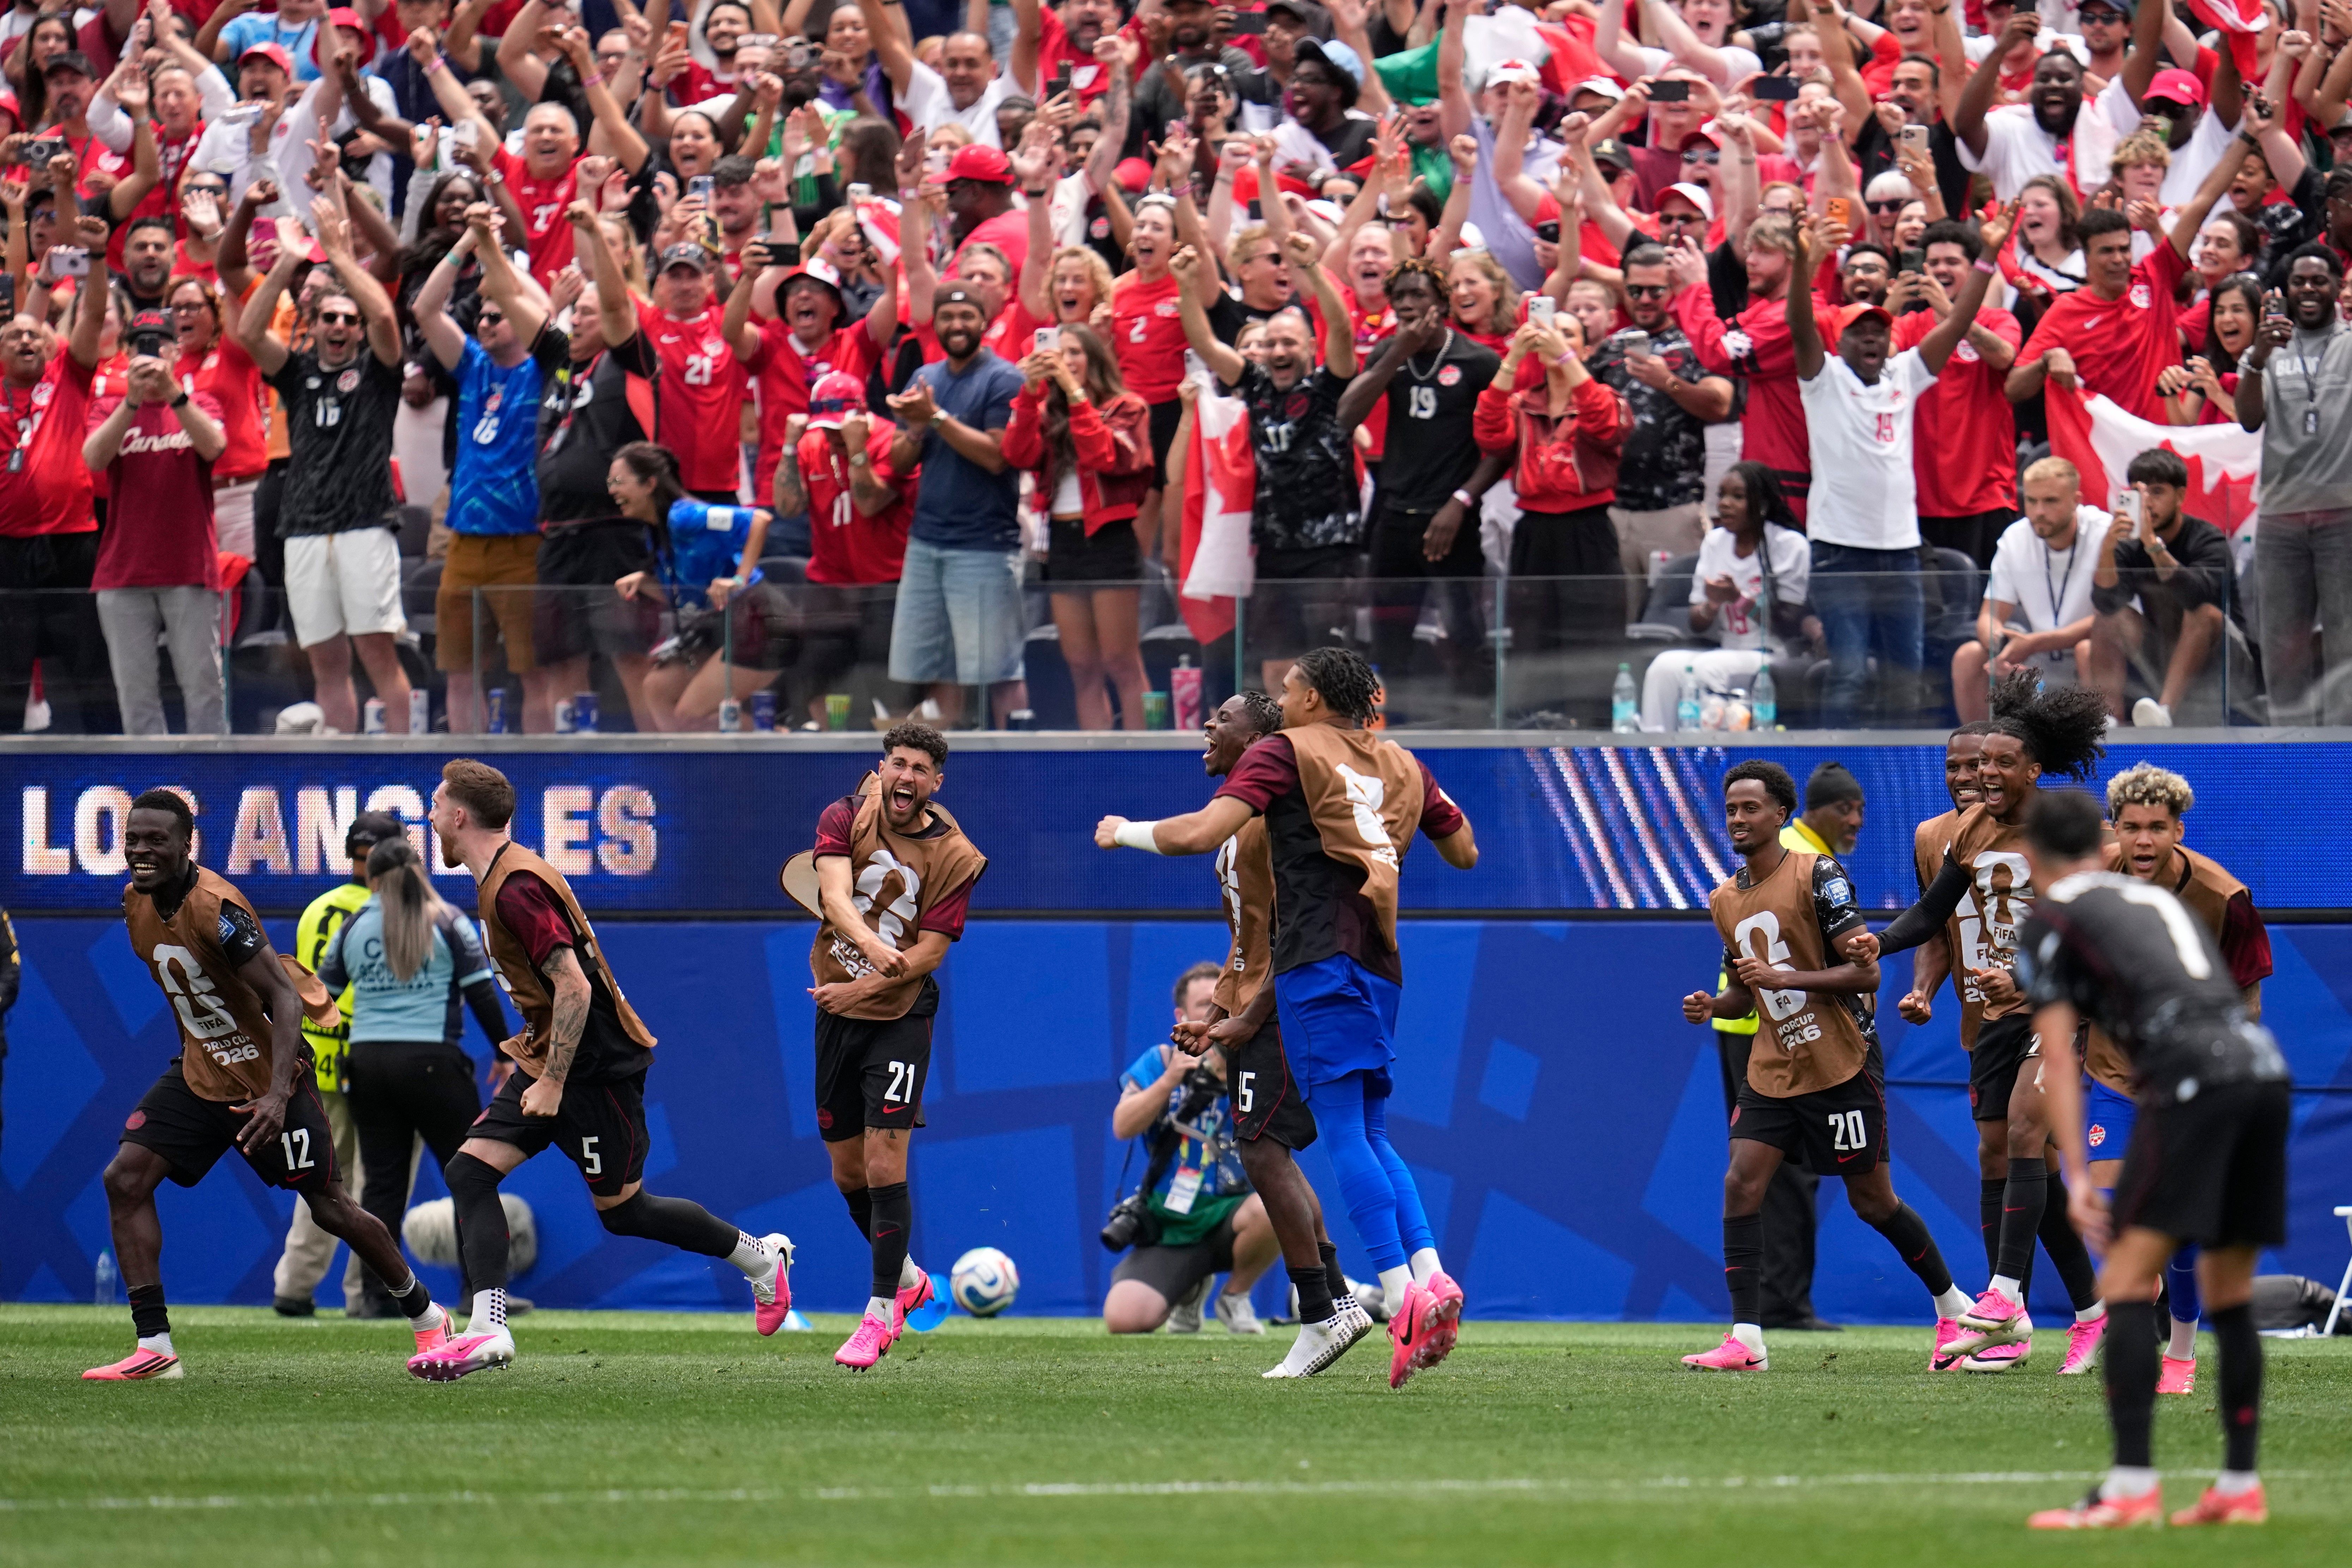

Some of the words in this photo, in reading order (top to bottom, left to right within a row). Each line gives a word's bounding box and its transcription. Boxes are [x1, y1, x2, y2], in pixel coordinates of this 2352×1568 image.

[1129, 316, 1148, 344] 2
[684, 353, 713, 386] 21
[1408, 385, 1436, 420] 19
[1994, 926, 2017, 941] FIFA
[884, 1061, 915, 1104] 21
[1828, 1110, 1867, 1150] 20
[281, 1128, 314, 1170] 12
[582, 1136, 602, 1174] 5
